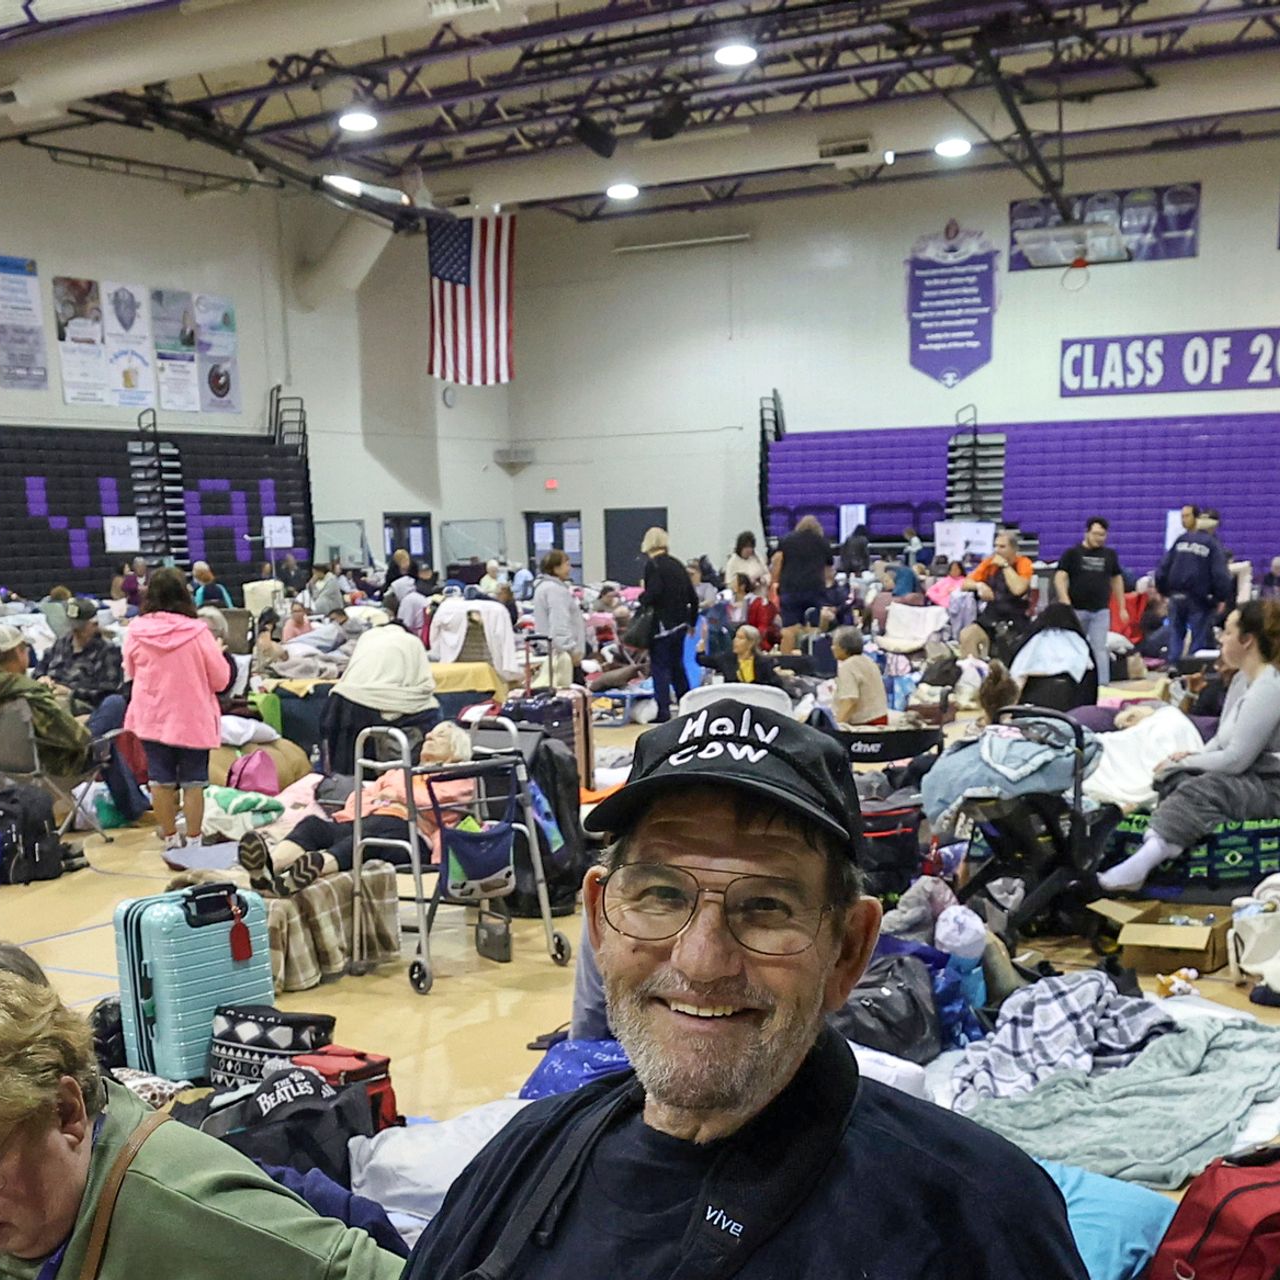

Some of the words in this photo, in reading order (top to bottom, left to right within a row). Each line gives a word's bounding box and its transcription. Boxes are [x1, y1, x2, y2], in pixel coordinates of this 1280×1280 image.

[1062, 338, 1165, 391] CLASS
[1181, 336, 1232, 385] OF
[256, 1081, 315, 1117] BEATLES
[273, 1080, 291, 1090] THE
[705, 1205, 744, 1237] vive
